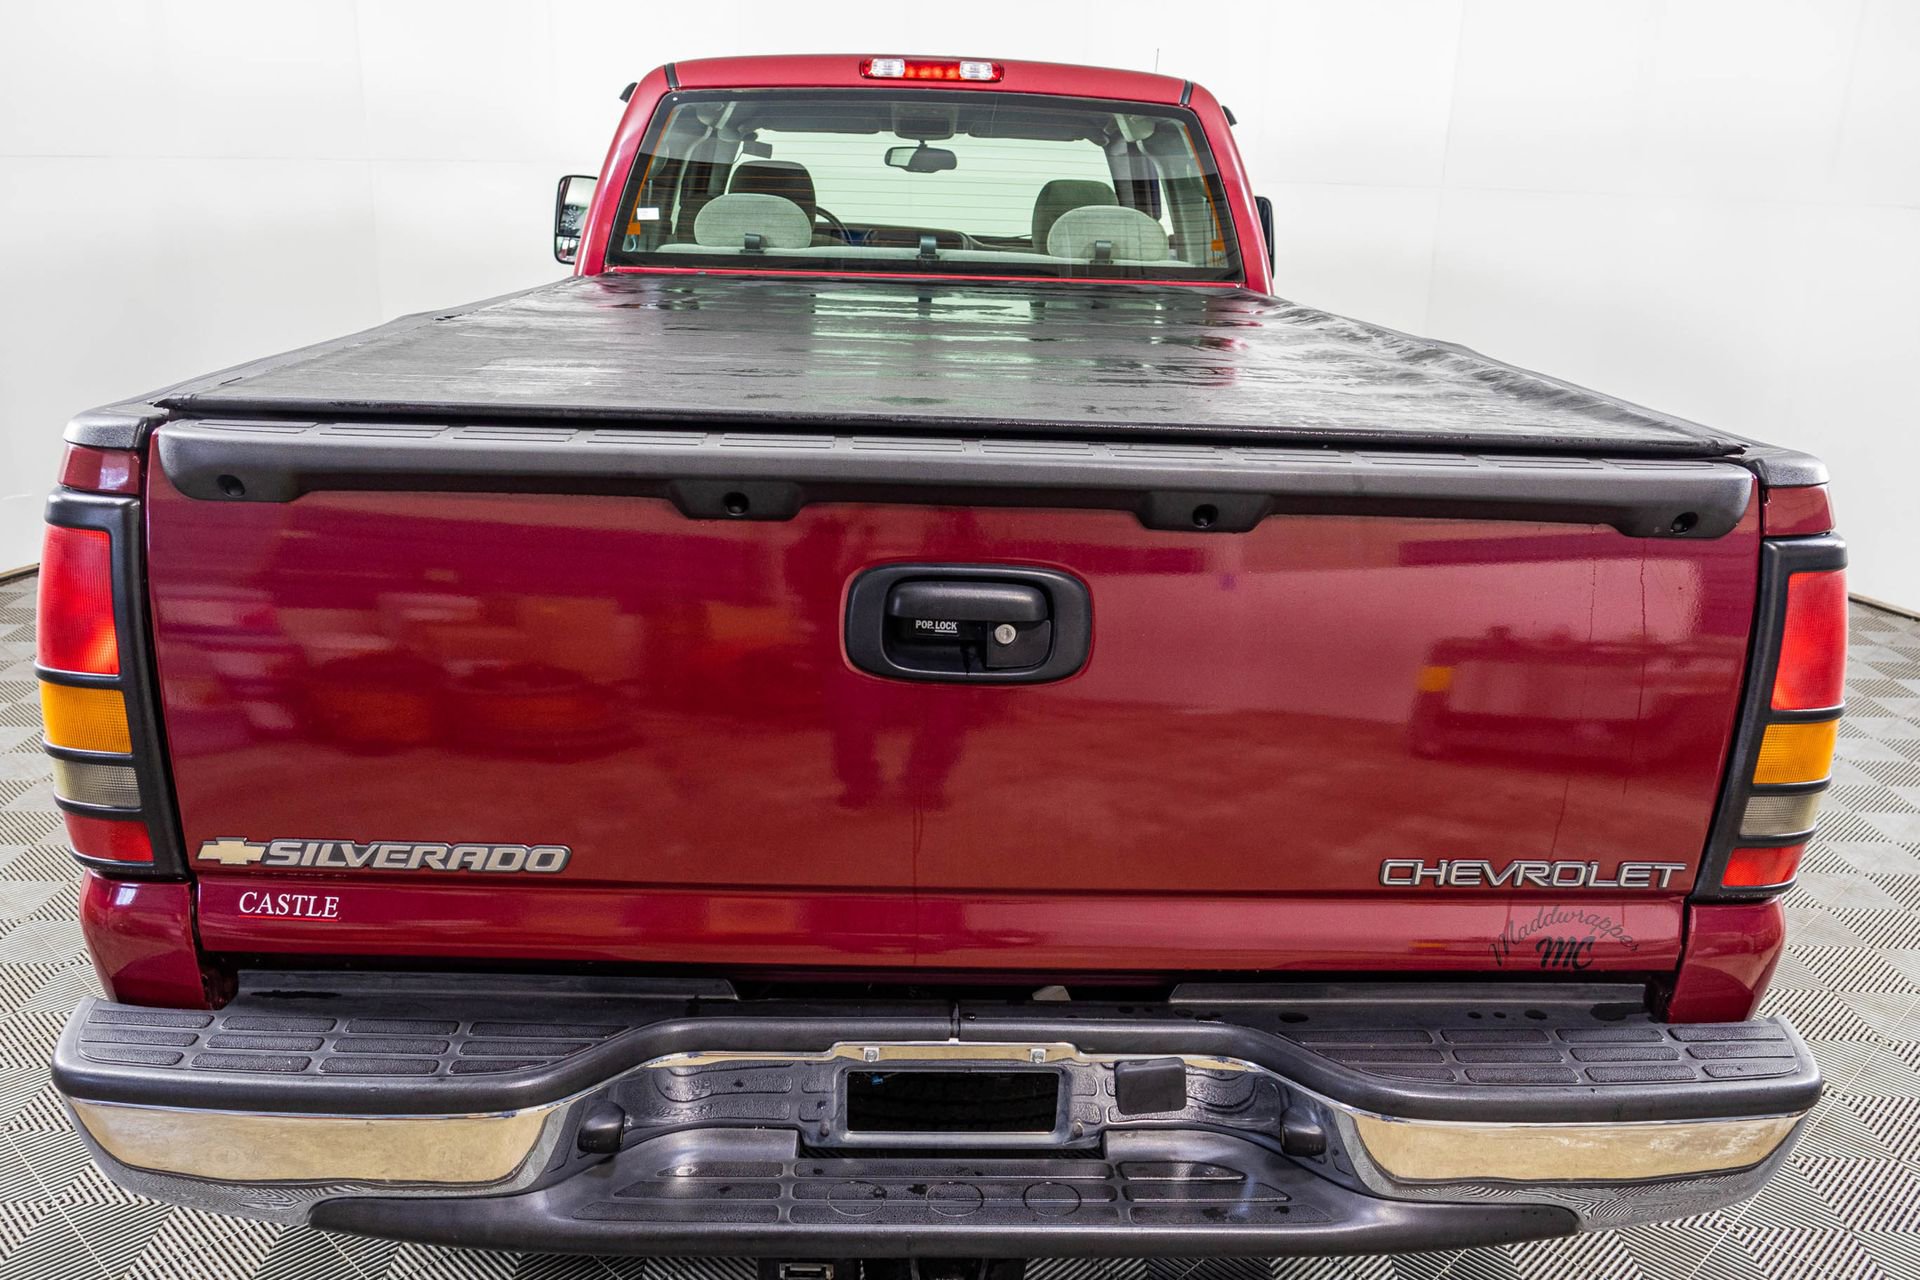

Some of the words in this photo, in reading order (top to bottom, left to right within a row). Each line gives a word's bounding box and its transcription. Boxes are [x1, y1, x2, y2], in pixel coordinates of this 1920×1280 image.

[935, 620, 958, 631] LOCK
[266, 840, 569, 873] SILVERADO
[1380, 859, 1687, 888] CHEVROLET
[239, 891, 339, 918] CASTLE
